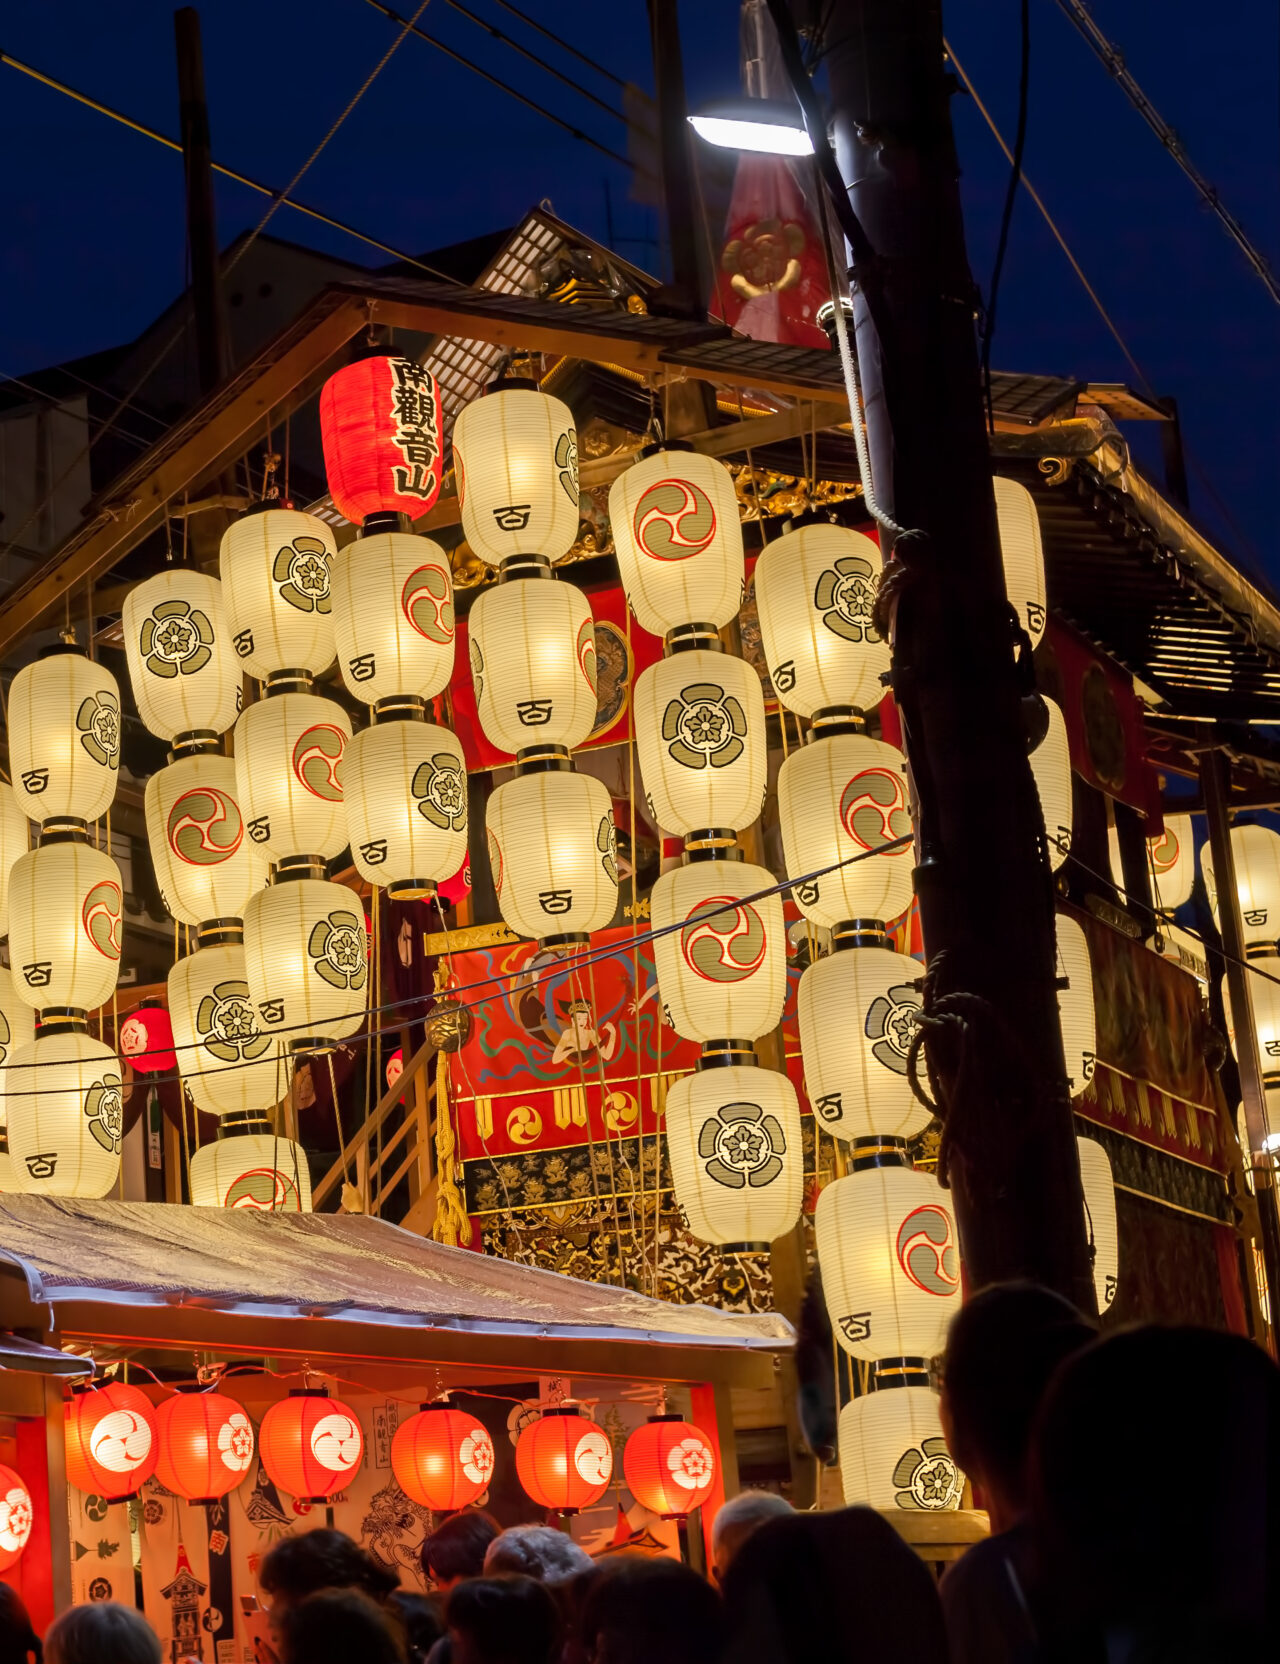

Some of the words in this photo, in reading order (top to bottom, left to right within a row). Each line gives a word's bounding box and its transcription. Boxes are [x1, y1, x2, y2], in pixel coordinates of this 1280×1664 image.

[389, 358, 439, 500] 南觀音山
[493, 505, 531, 531] 百
[1026, 602, 1045, 634] 百
[233, 628, 254, 658] 百
[349, 653, 375, 682] 百
[773, 660, 796, 693] 百
[517, 700, 552, 726] 百
[22, 768, 50, 795] 百
[247, 816, 271, 843] 百
[359, 839, 388, 865] 百
[539, 890, 572, 915] 百
[1243, 909, 1268, 926] 百
[23, 961, 52, 987] 百
[258, 999, 284, 1023] 百
[815, 1093, 843, 1122] 百
[25, 1153, 57, 1179] 百
[838, 1312, 872, 1342] 百
